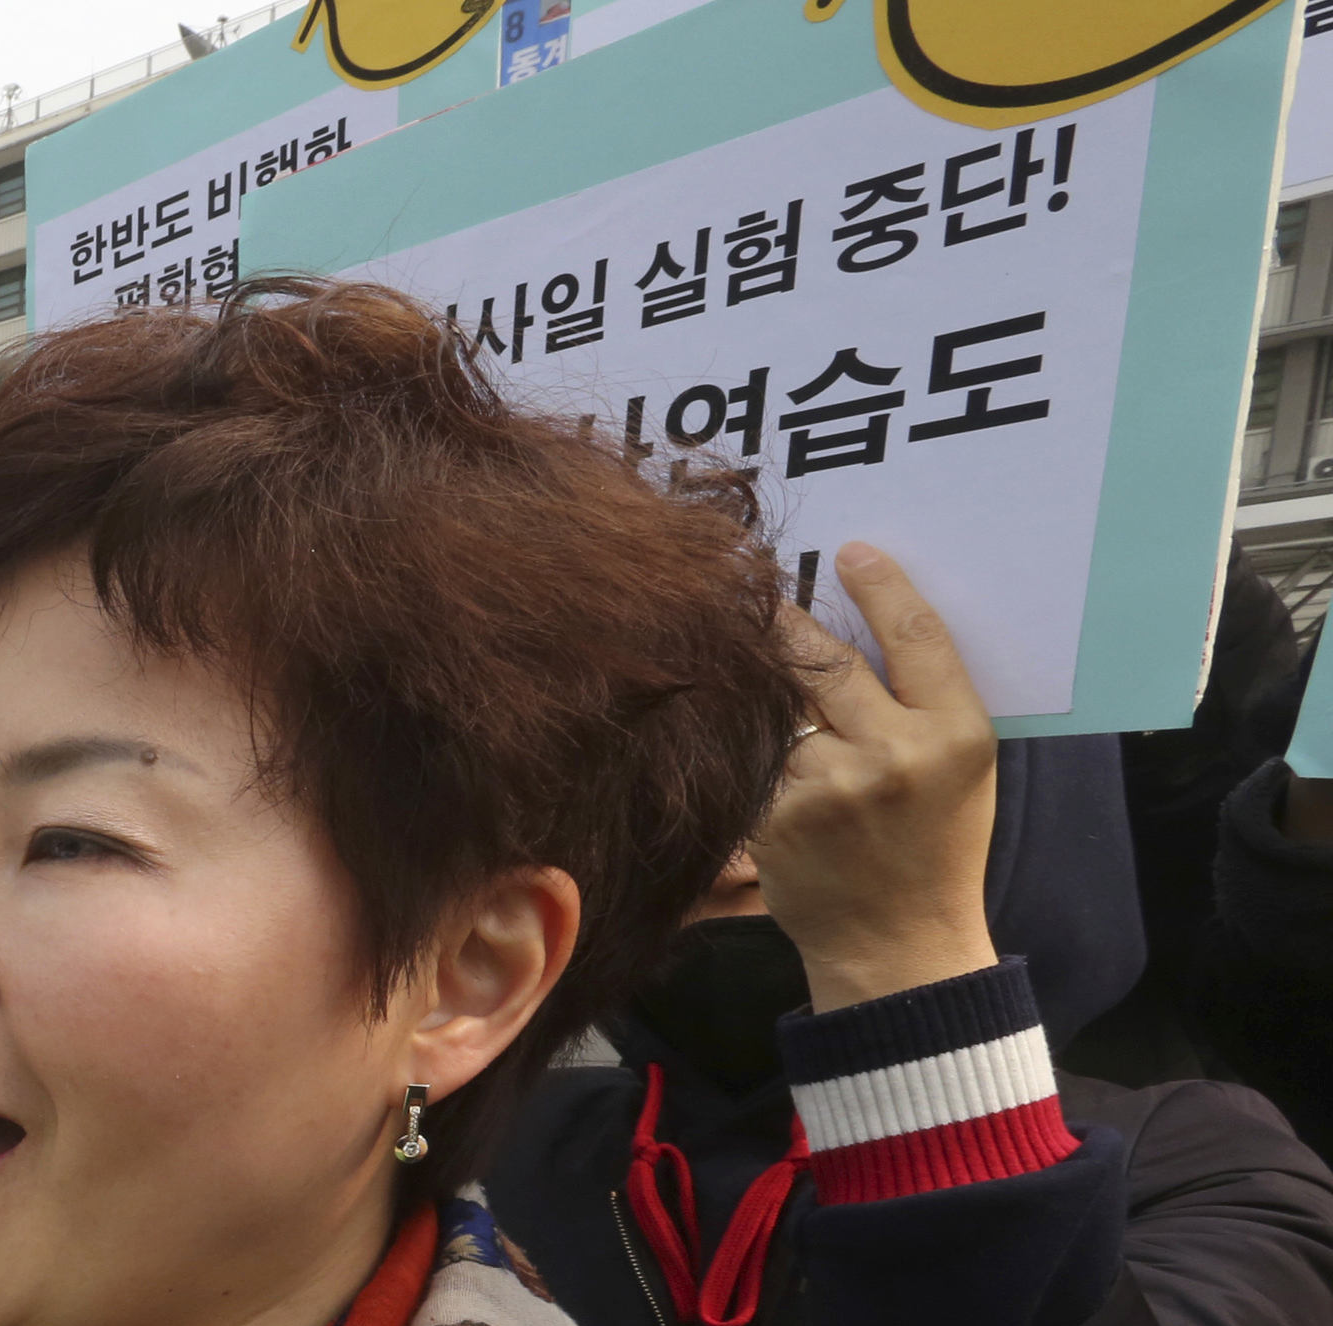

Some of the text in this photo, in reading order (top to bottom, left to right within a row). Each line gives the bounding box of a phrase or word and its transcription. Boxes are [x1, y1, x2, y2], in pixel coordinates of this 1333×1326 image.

[69, 189, 194, 287] 한반도
[635, 198, 804, 329] 실험
[832, 122, 1077, 274] 중단!
